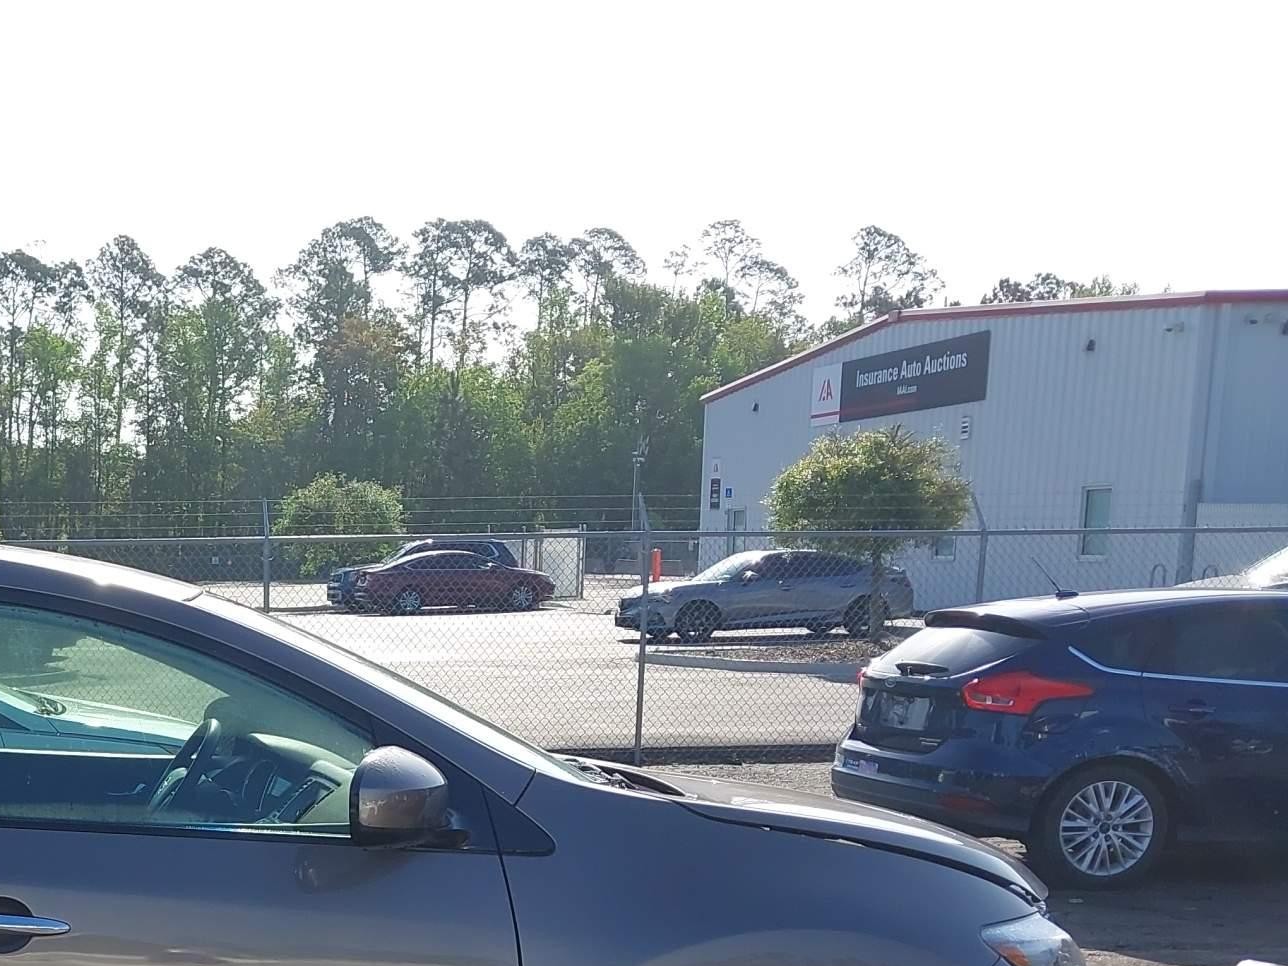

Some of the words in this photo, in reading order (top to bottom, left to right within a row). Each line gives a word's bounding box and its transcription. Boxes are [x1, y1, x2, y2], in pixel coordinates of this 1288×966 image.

[856, 367, 898, 388] Insurance
[900, 360, 922, 380] Auto
[923, 351, 968, 376] Auctions
